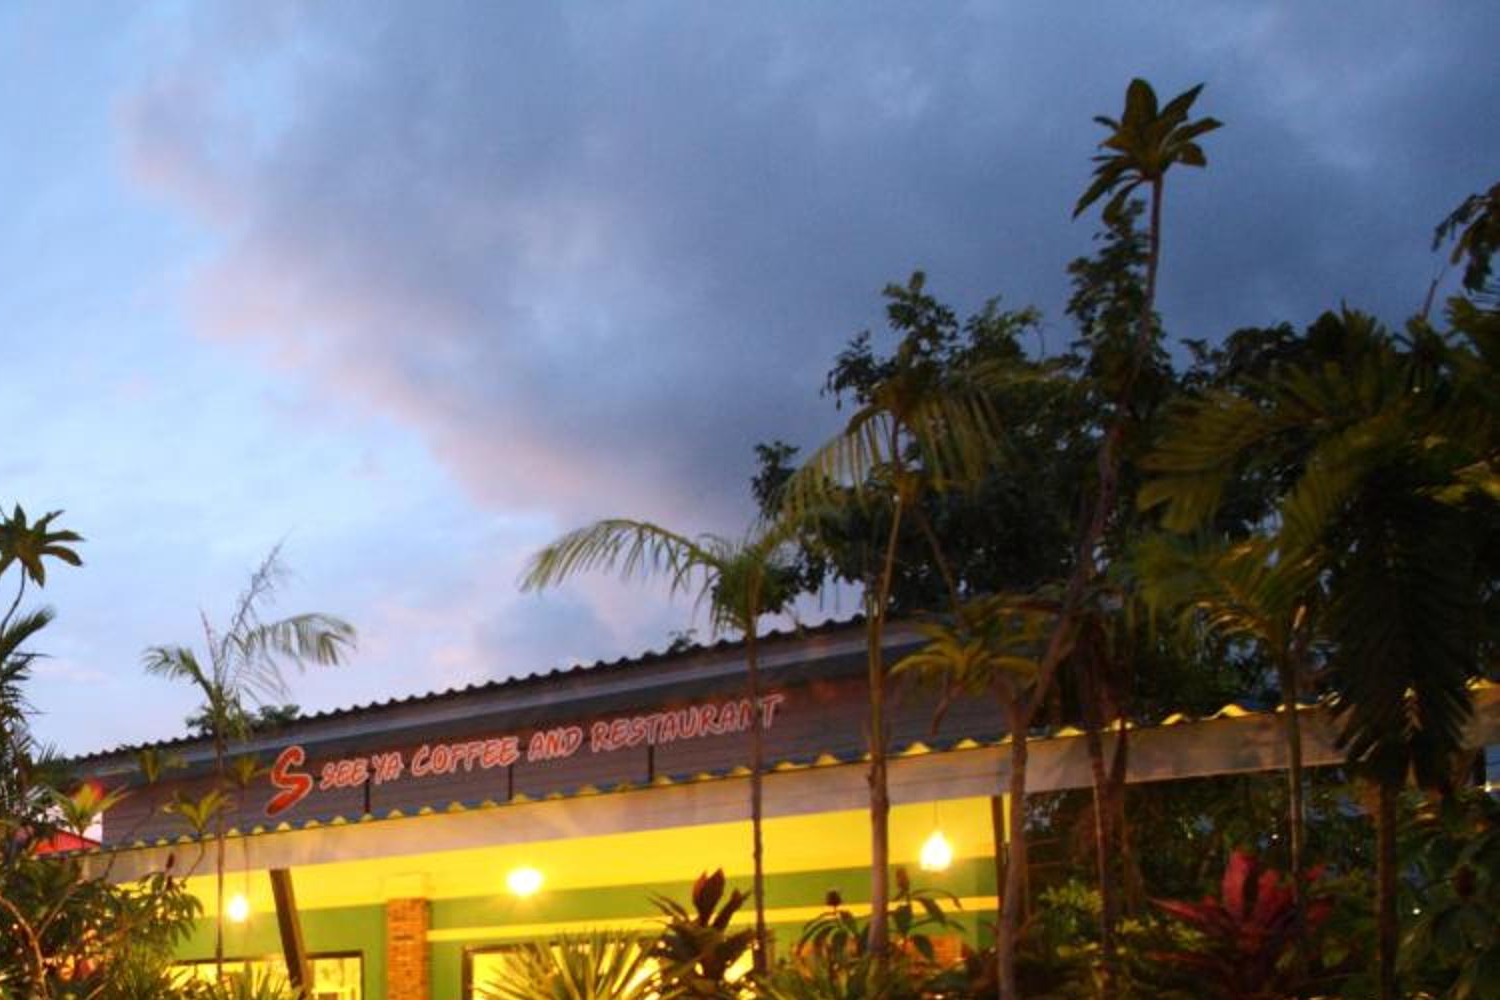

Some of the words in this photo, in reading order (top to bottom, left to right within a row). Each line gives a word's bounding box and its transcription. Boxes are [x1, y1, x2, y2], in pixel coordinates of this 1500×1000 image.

[319, 757, 370, 791] SEE
[371, 751, 404, 785] YA
[411, 735, 520, 777] COFFEE
[527, 724, 583, 762] AND
